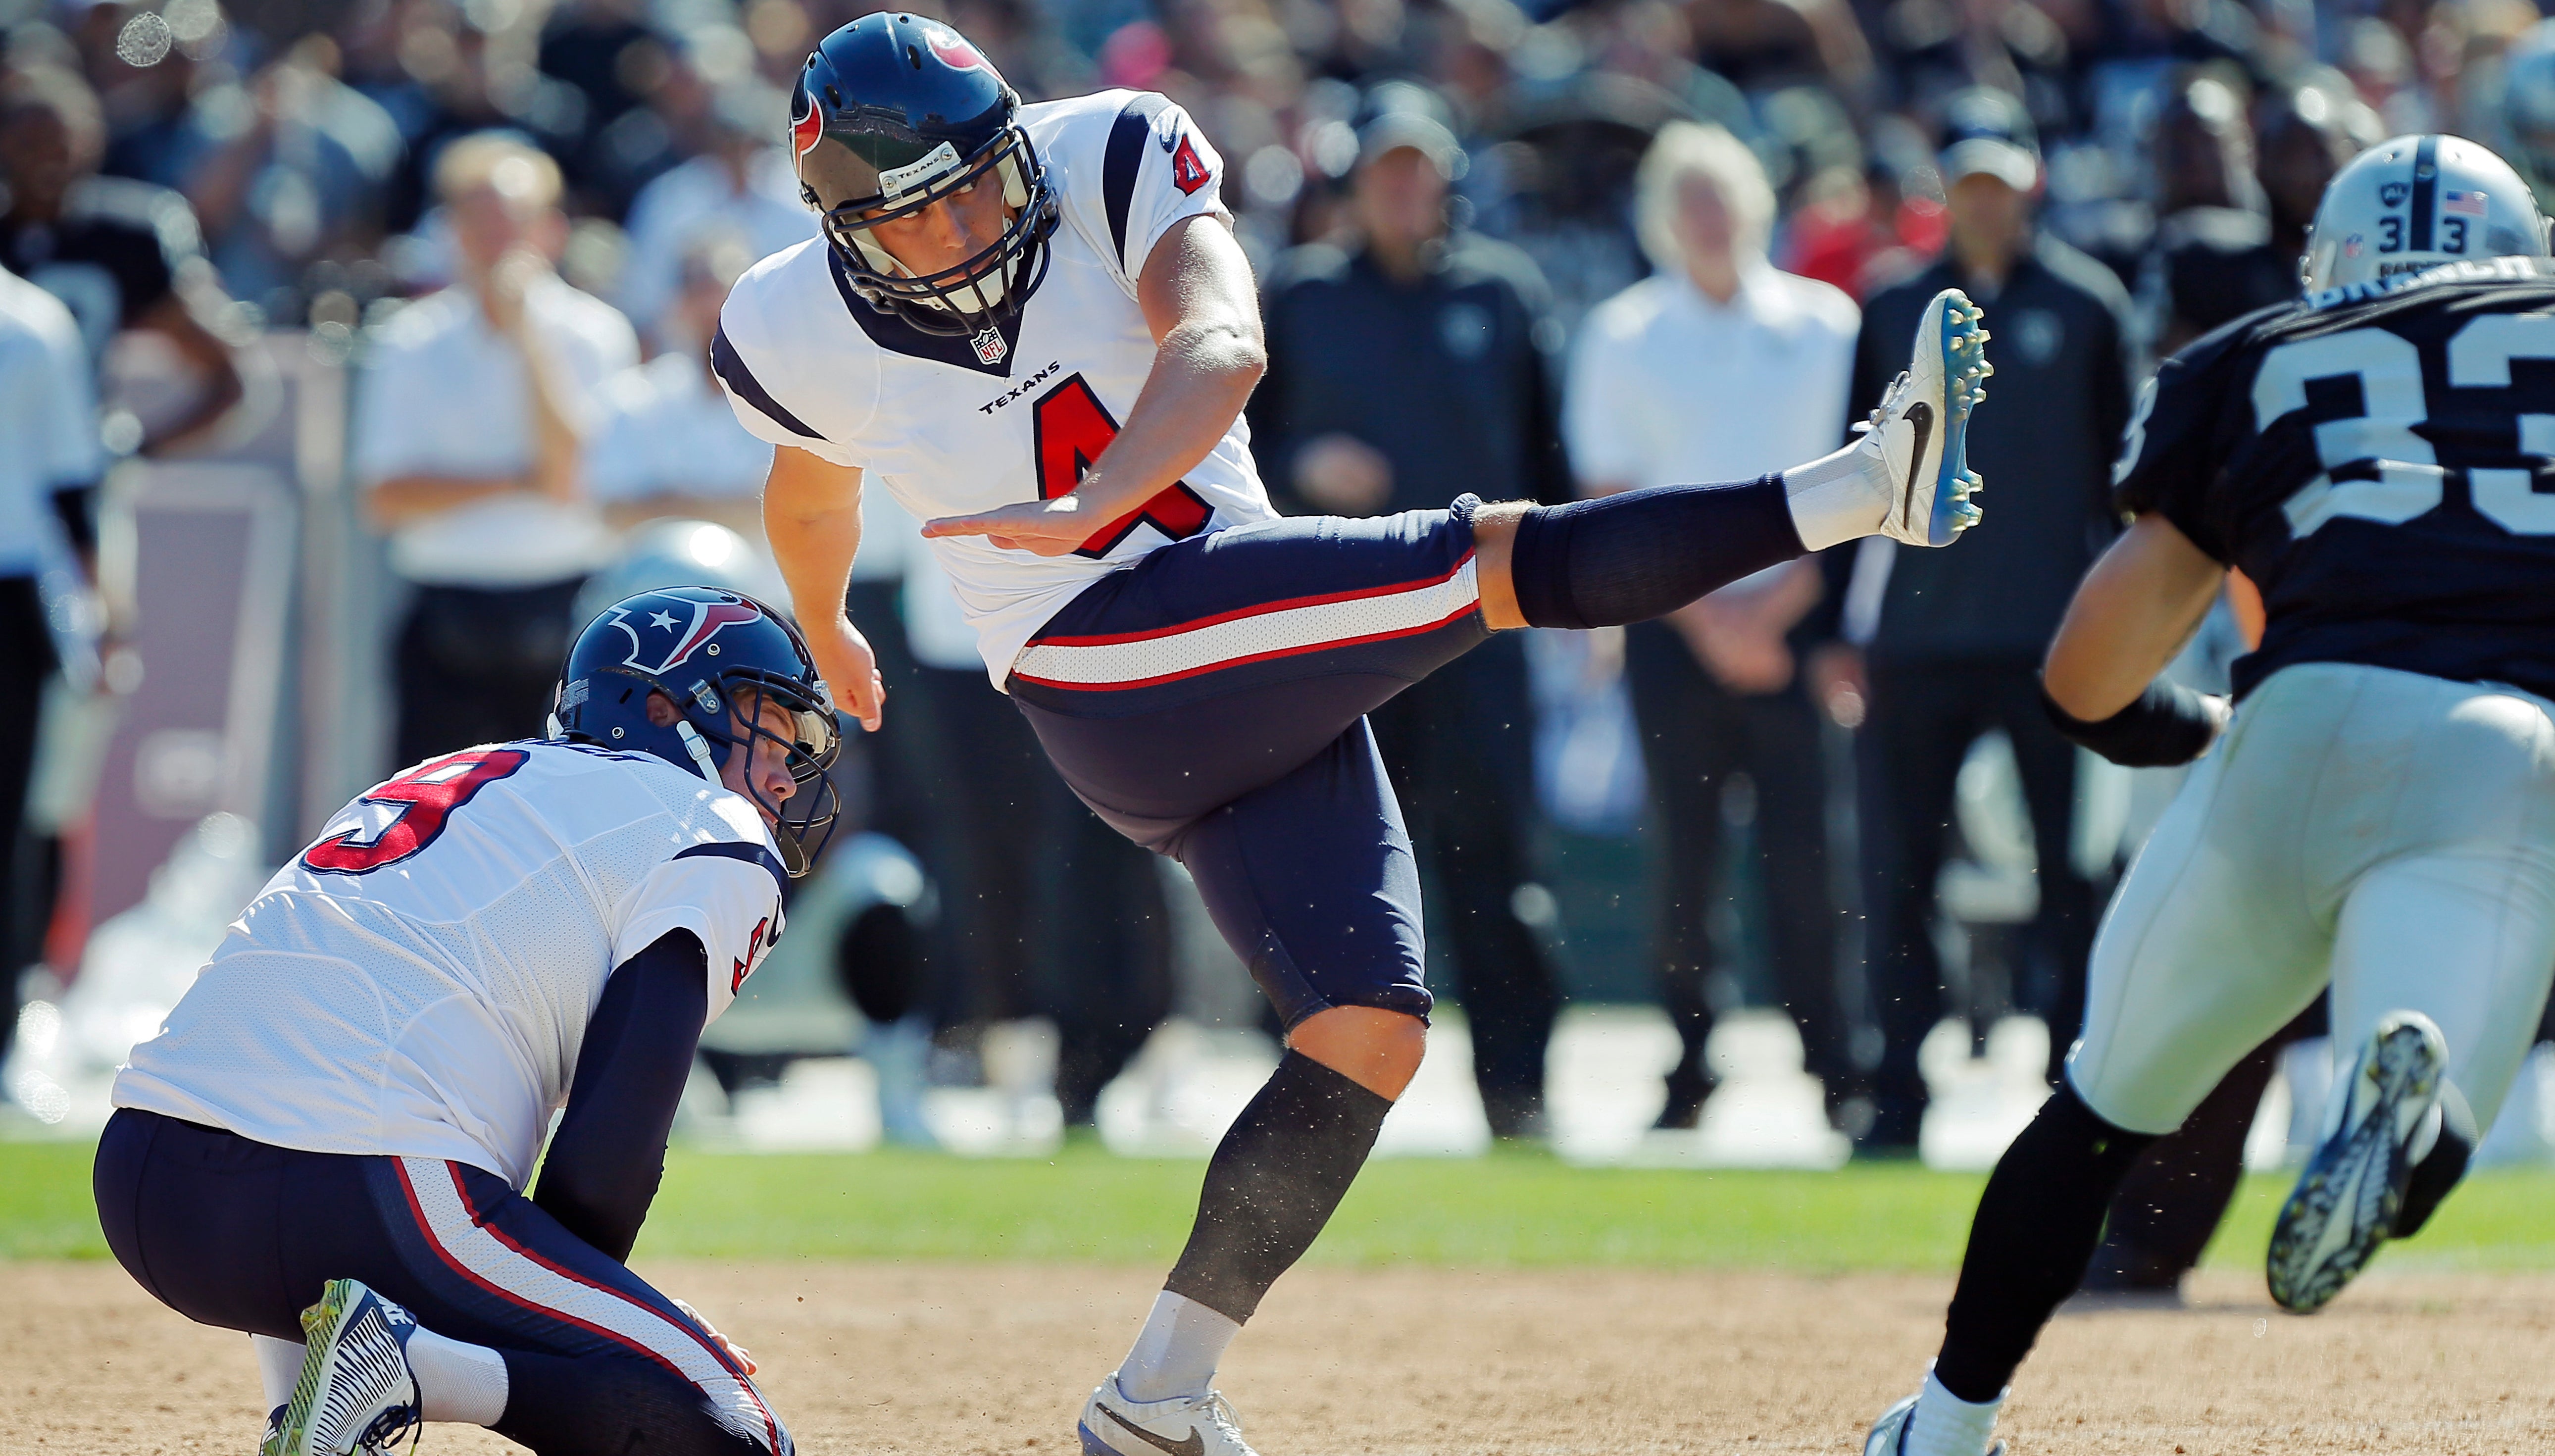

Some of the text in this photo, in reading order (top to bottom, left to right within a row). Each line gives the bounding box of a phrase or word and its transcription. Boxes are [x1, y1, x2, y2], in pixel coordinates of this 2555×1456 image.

[898, 156, 940, 179] TEXANS
[1173, 132, 1211, 197] 4
[981, 341, 1003, 359] NFL
[978, 360, 1060, 414] TEXANS
[1032, 371, 1216, 560] 4
[299, 749, 531, 876] 9
